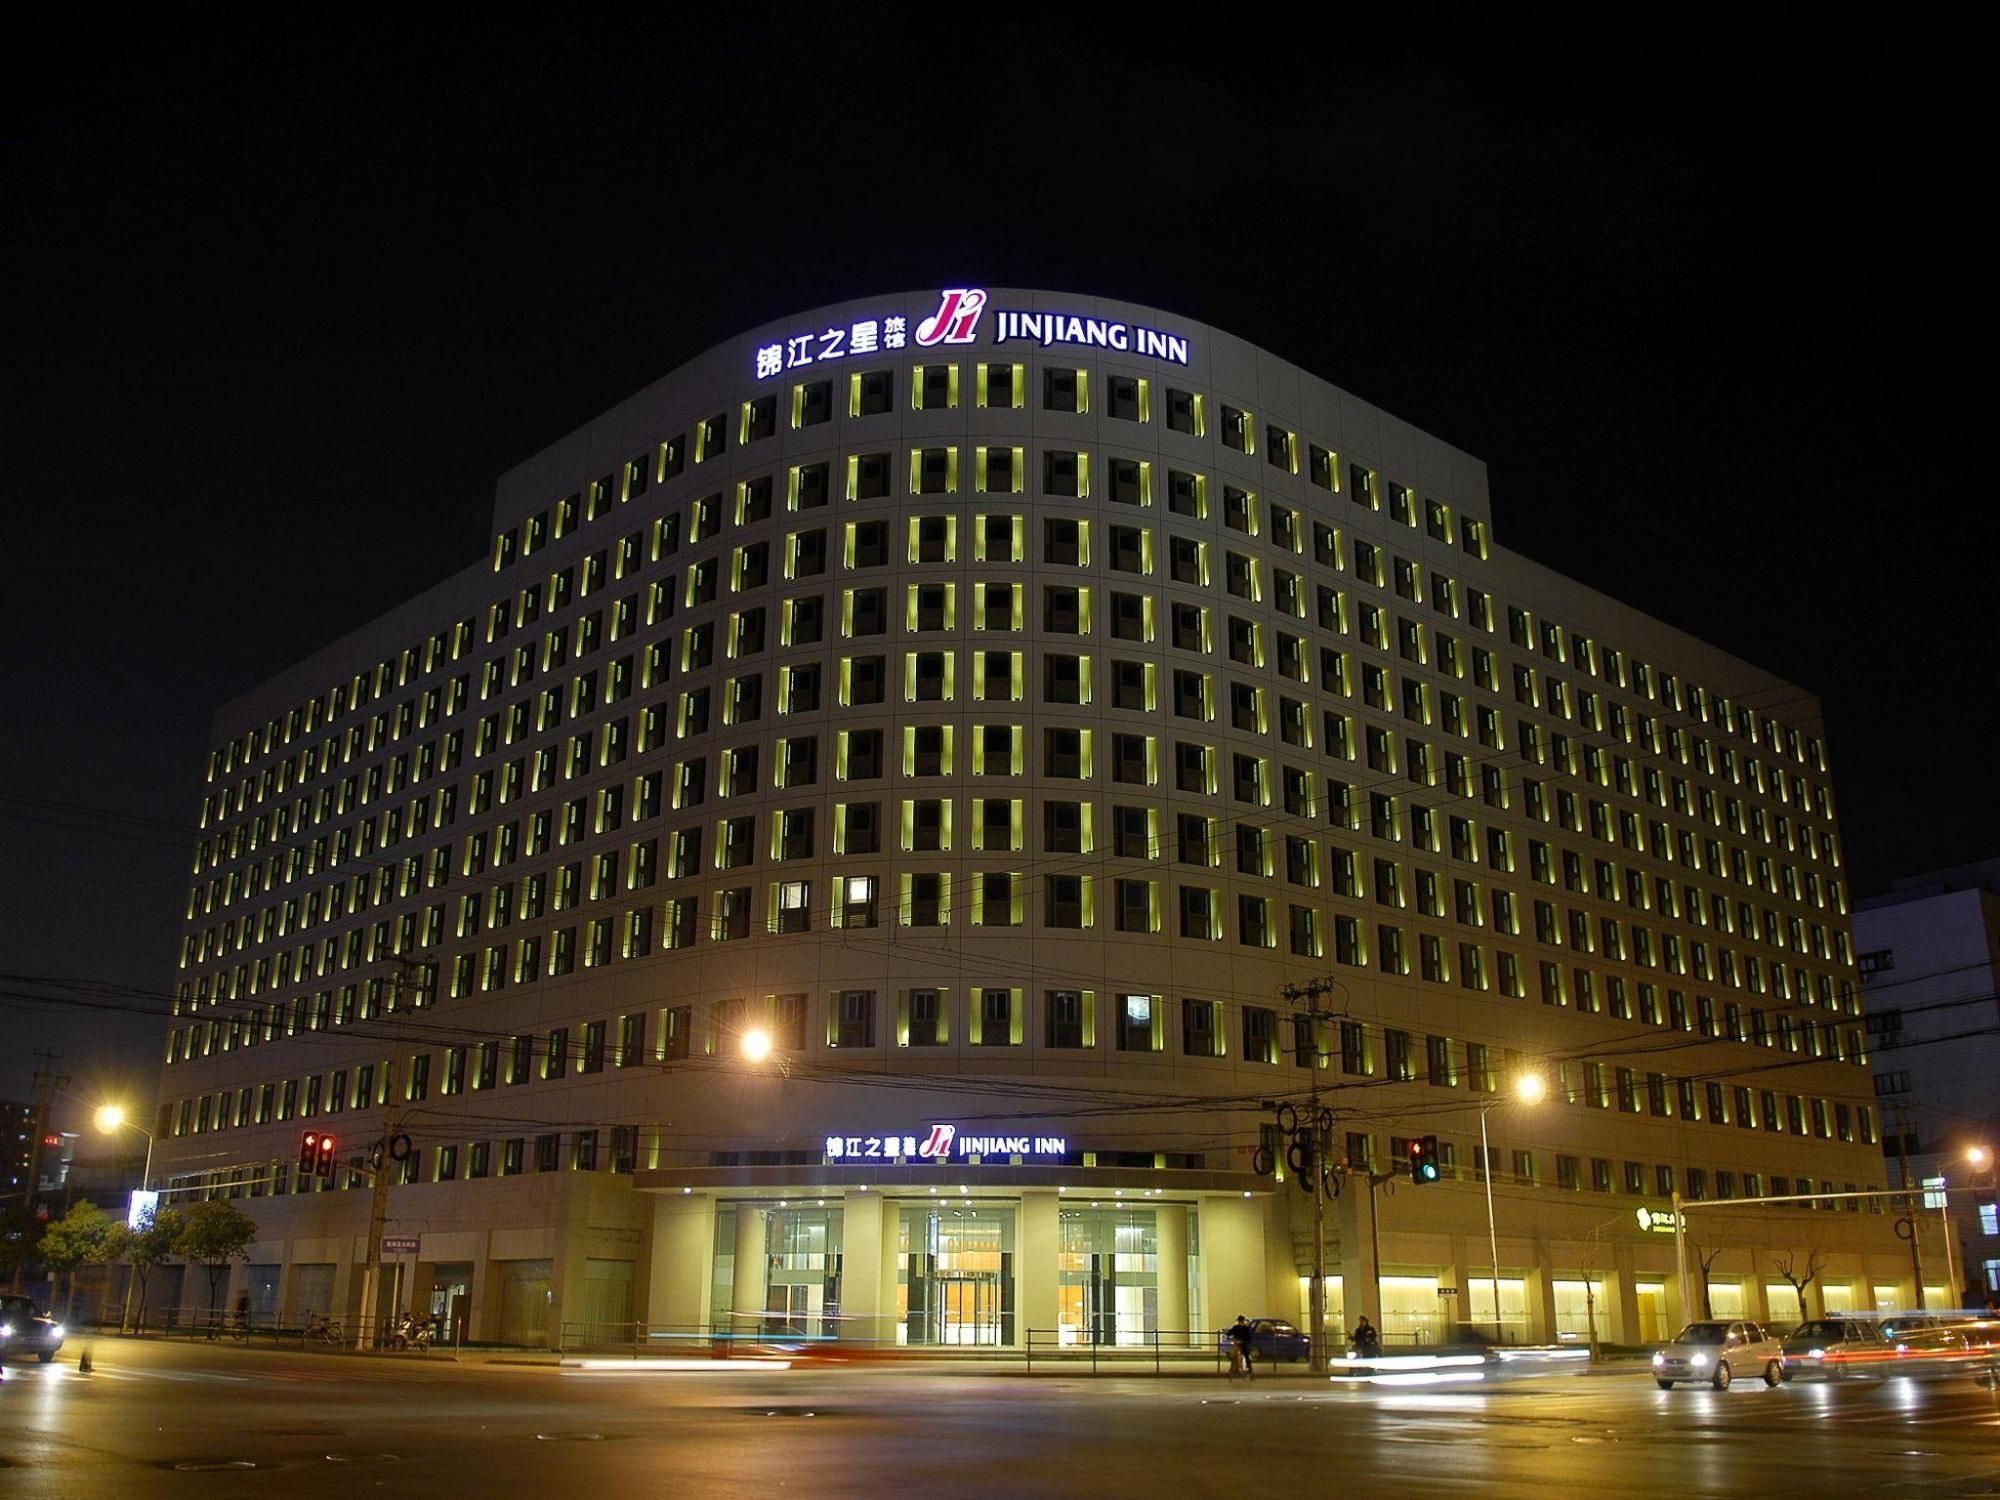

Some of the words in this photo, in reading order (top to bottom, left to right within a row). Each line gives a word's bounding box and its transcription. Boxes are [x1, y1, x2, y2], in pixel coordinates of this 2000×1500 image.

[756, 320, 879, 379] 锦江之星
[997, 312, 1128, 350] JINJIANG
[1137, 328, 1188, 364] INN
[959, 1136, 1031, 1157] JINJIANG
[1034, 1137, 1066, 1155] INN
